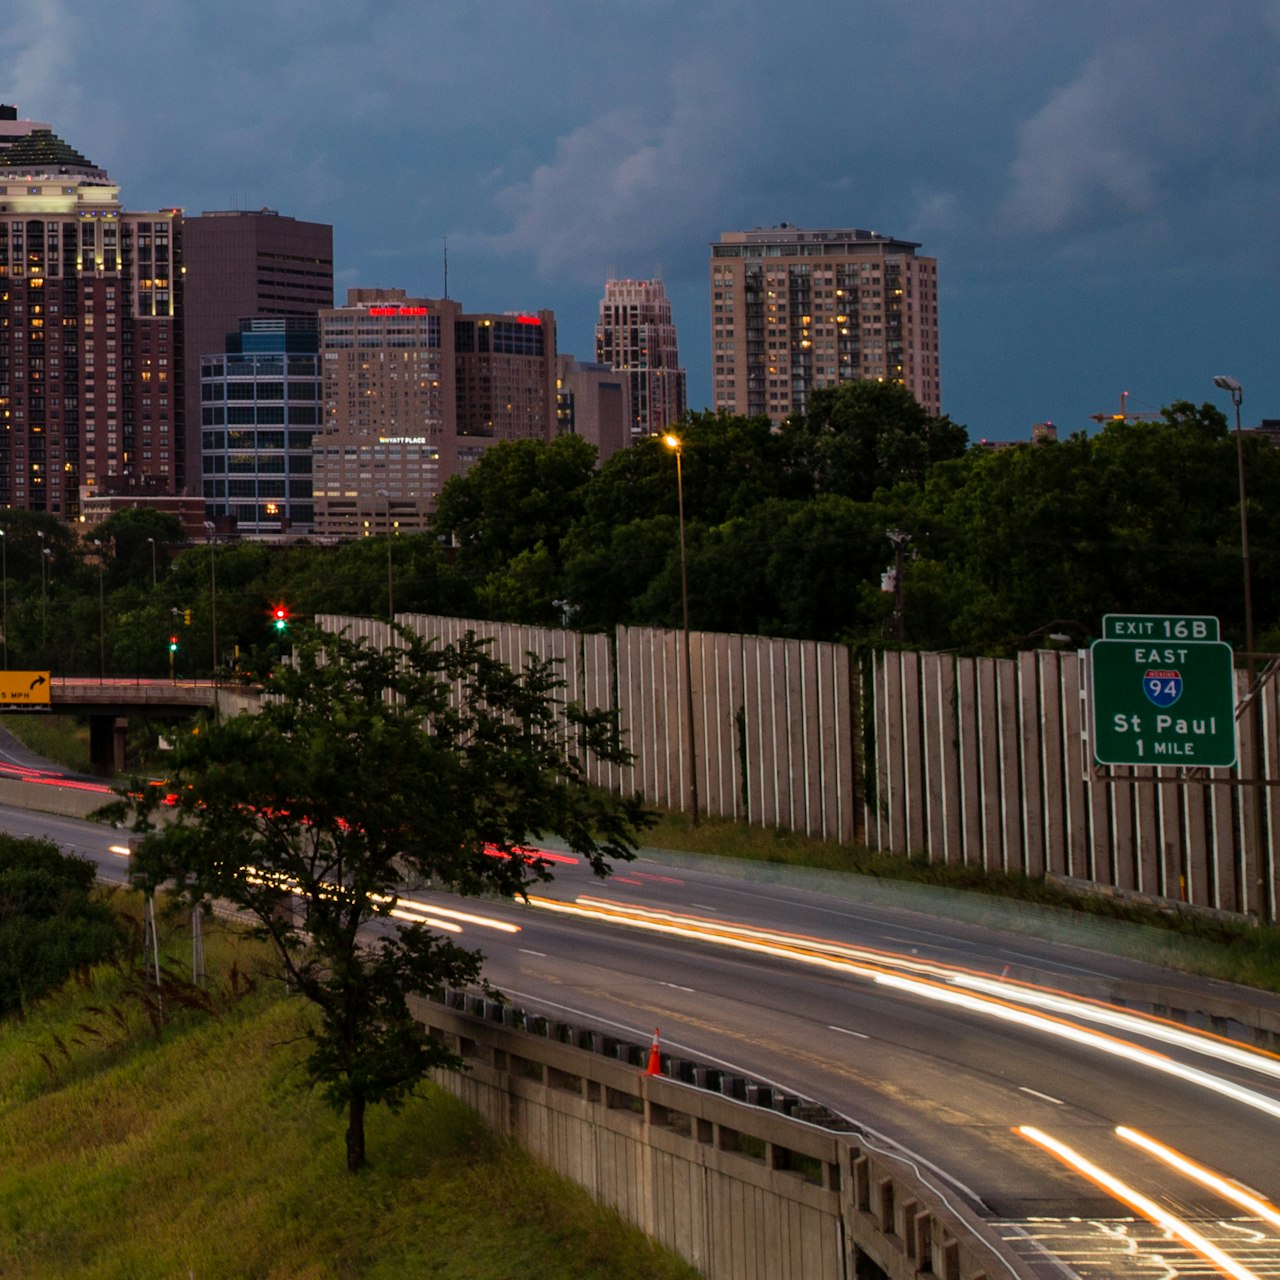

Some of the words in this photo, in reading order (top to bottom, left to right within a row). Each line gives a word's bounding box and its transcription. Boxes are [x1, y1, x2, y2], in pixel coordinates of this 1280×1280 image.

[1115, 622, 1154, 634] EXIT
[1164, 621, 1207, 638] 16B
[1135, 649, 1188, 663] EAST
[1149, 680, 1177, 697] 94
[1114, 714, 1141, 732] St
[1157, 715, 1216, 734] Paul
[1136, 739, 1143, 756] 1
[1154, 742, 1194, 755] MILE
